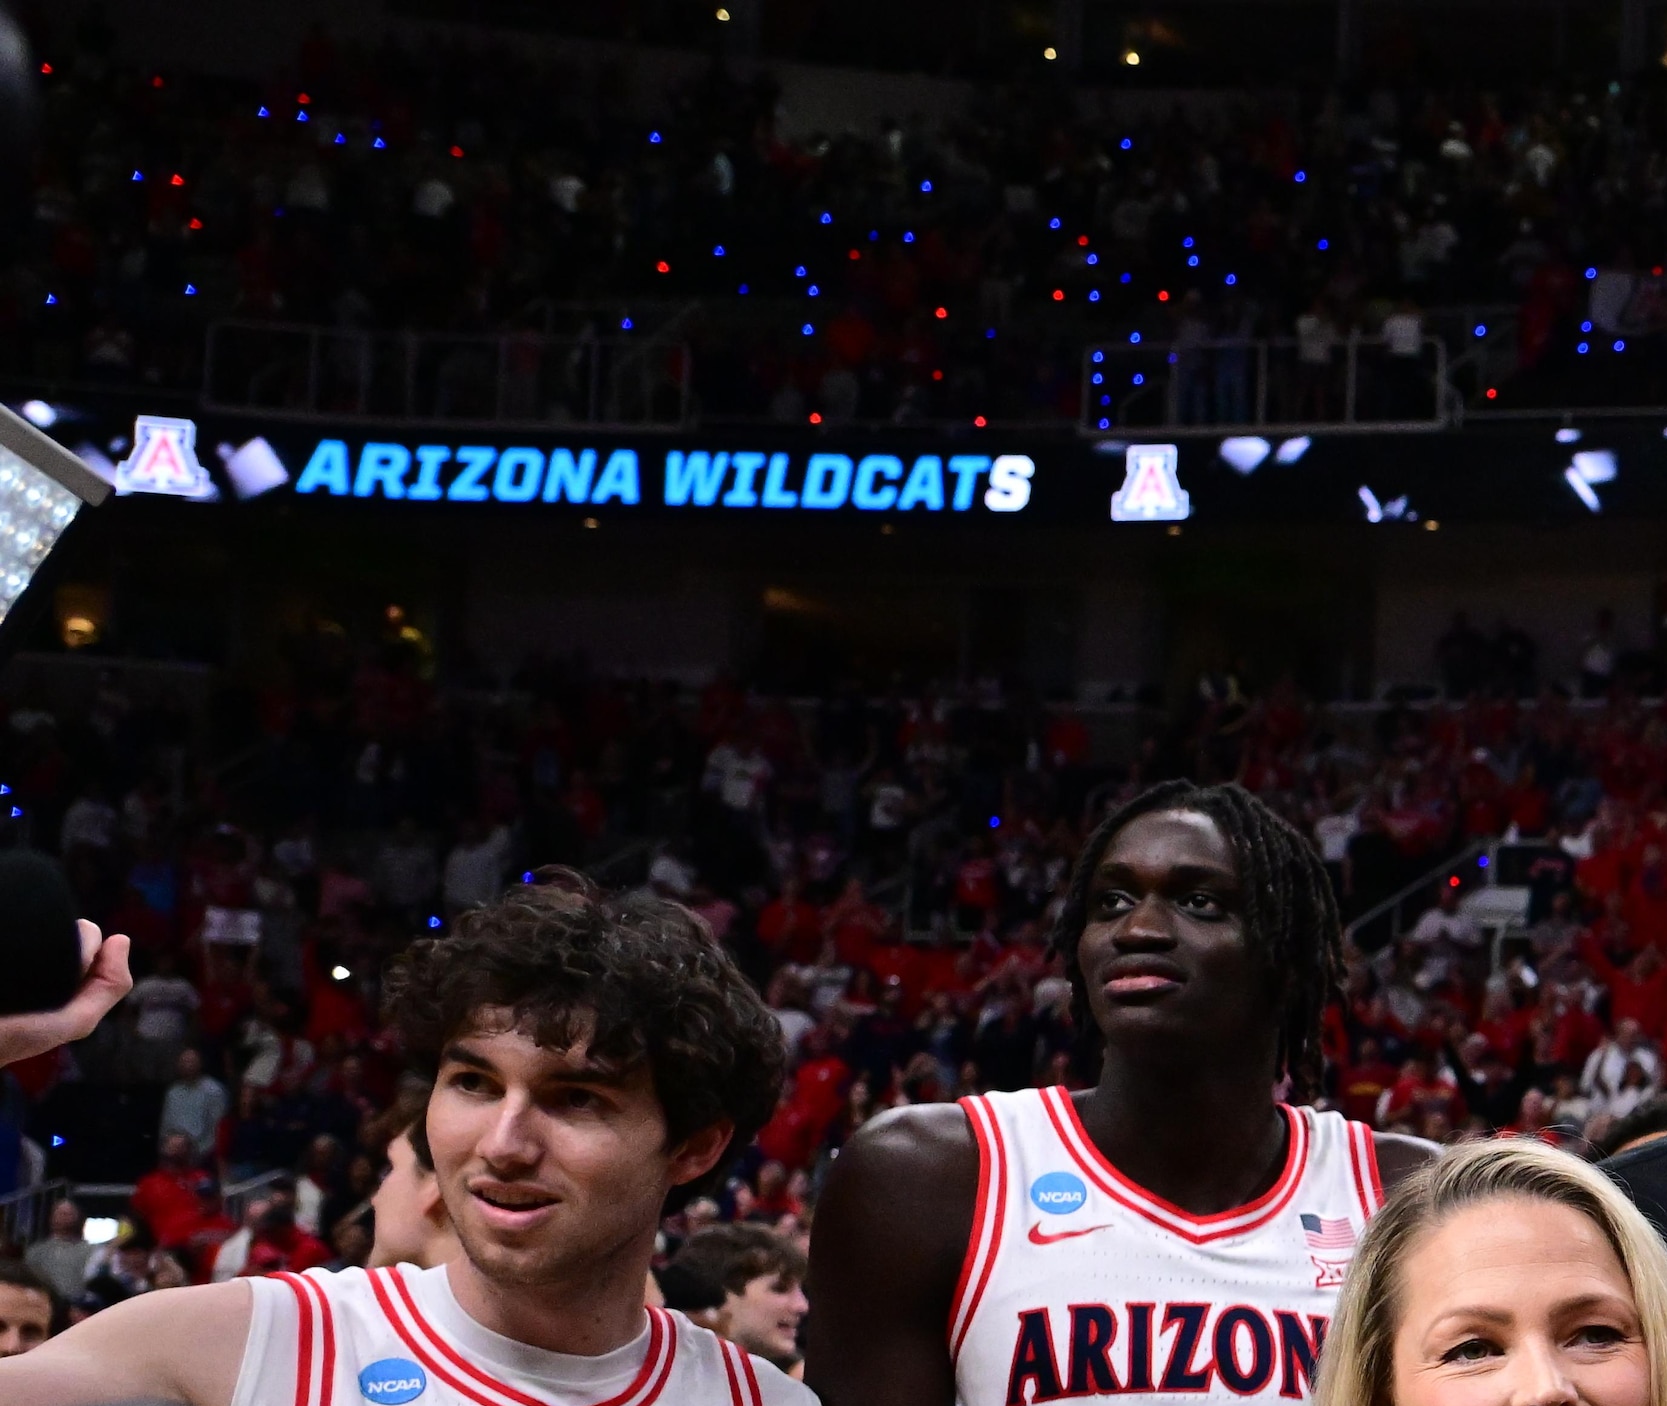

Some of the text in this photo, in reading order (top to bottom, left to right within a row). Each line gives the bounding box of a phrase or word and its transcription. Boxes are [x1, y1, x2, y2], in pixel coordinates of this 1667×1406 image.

[116, 414, 206, 497] A
[295, 439, 1036, 512] ARIZONA WILDCATS
[1110, 443, 1190, 521] A
[1038, 1191, 1082, 1203] NCAA
[367, 1378, 422, 1394] NCAA
